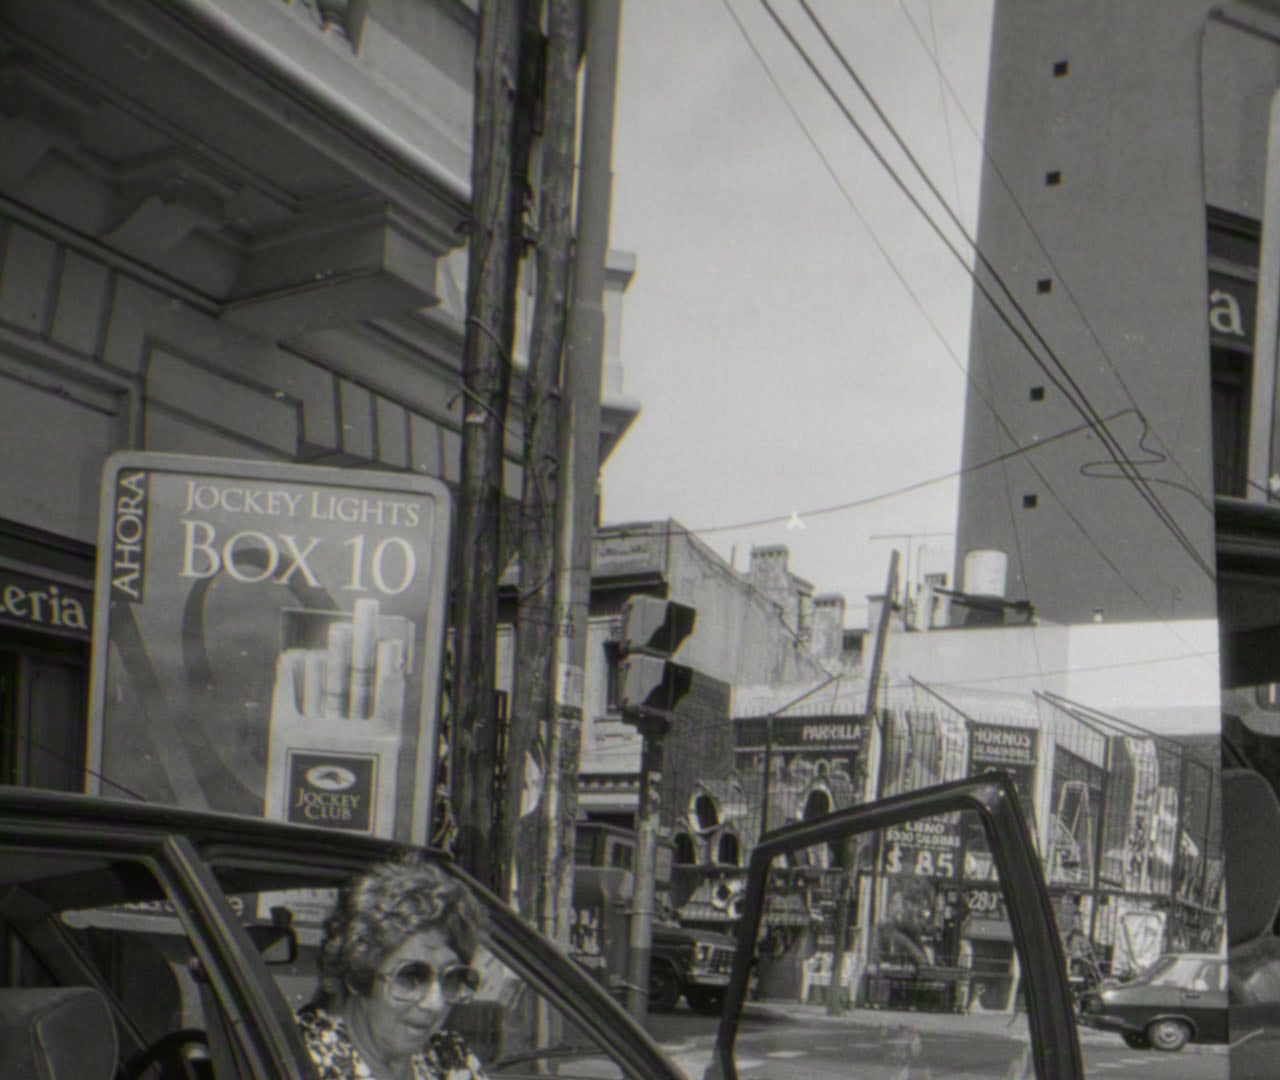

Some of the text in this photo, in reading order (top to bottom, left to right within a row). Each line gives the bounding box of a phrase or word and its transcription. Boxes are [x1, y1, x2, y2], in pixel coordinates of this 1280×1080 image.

[183, 481, 420, 528] JOCKEY LIGHTS
[113, 472, 145, 598] AHORA
[180, 519, 417, 595] BOX 10
[0, 583, 89, 630] eria
[802, 723, 861, 741] PARRILLA
[295, 787, 361, 809] JOCKEY
[303, 802, 353, 821] CLUB
[914, 850, 954, 878] 85
